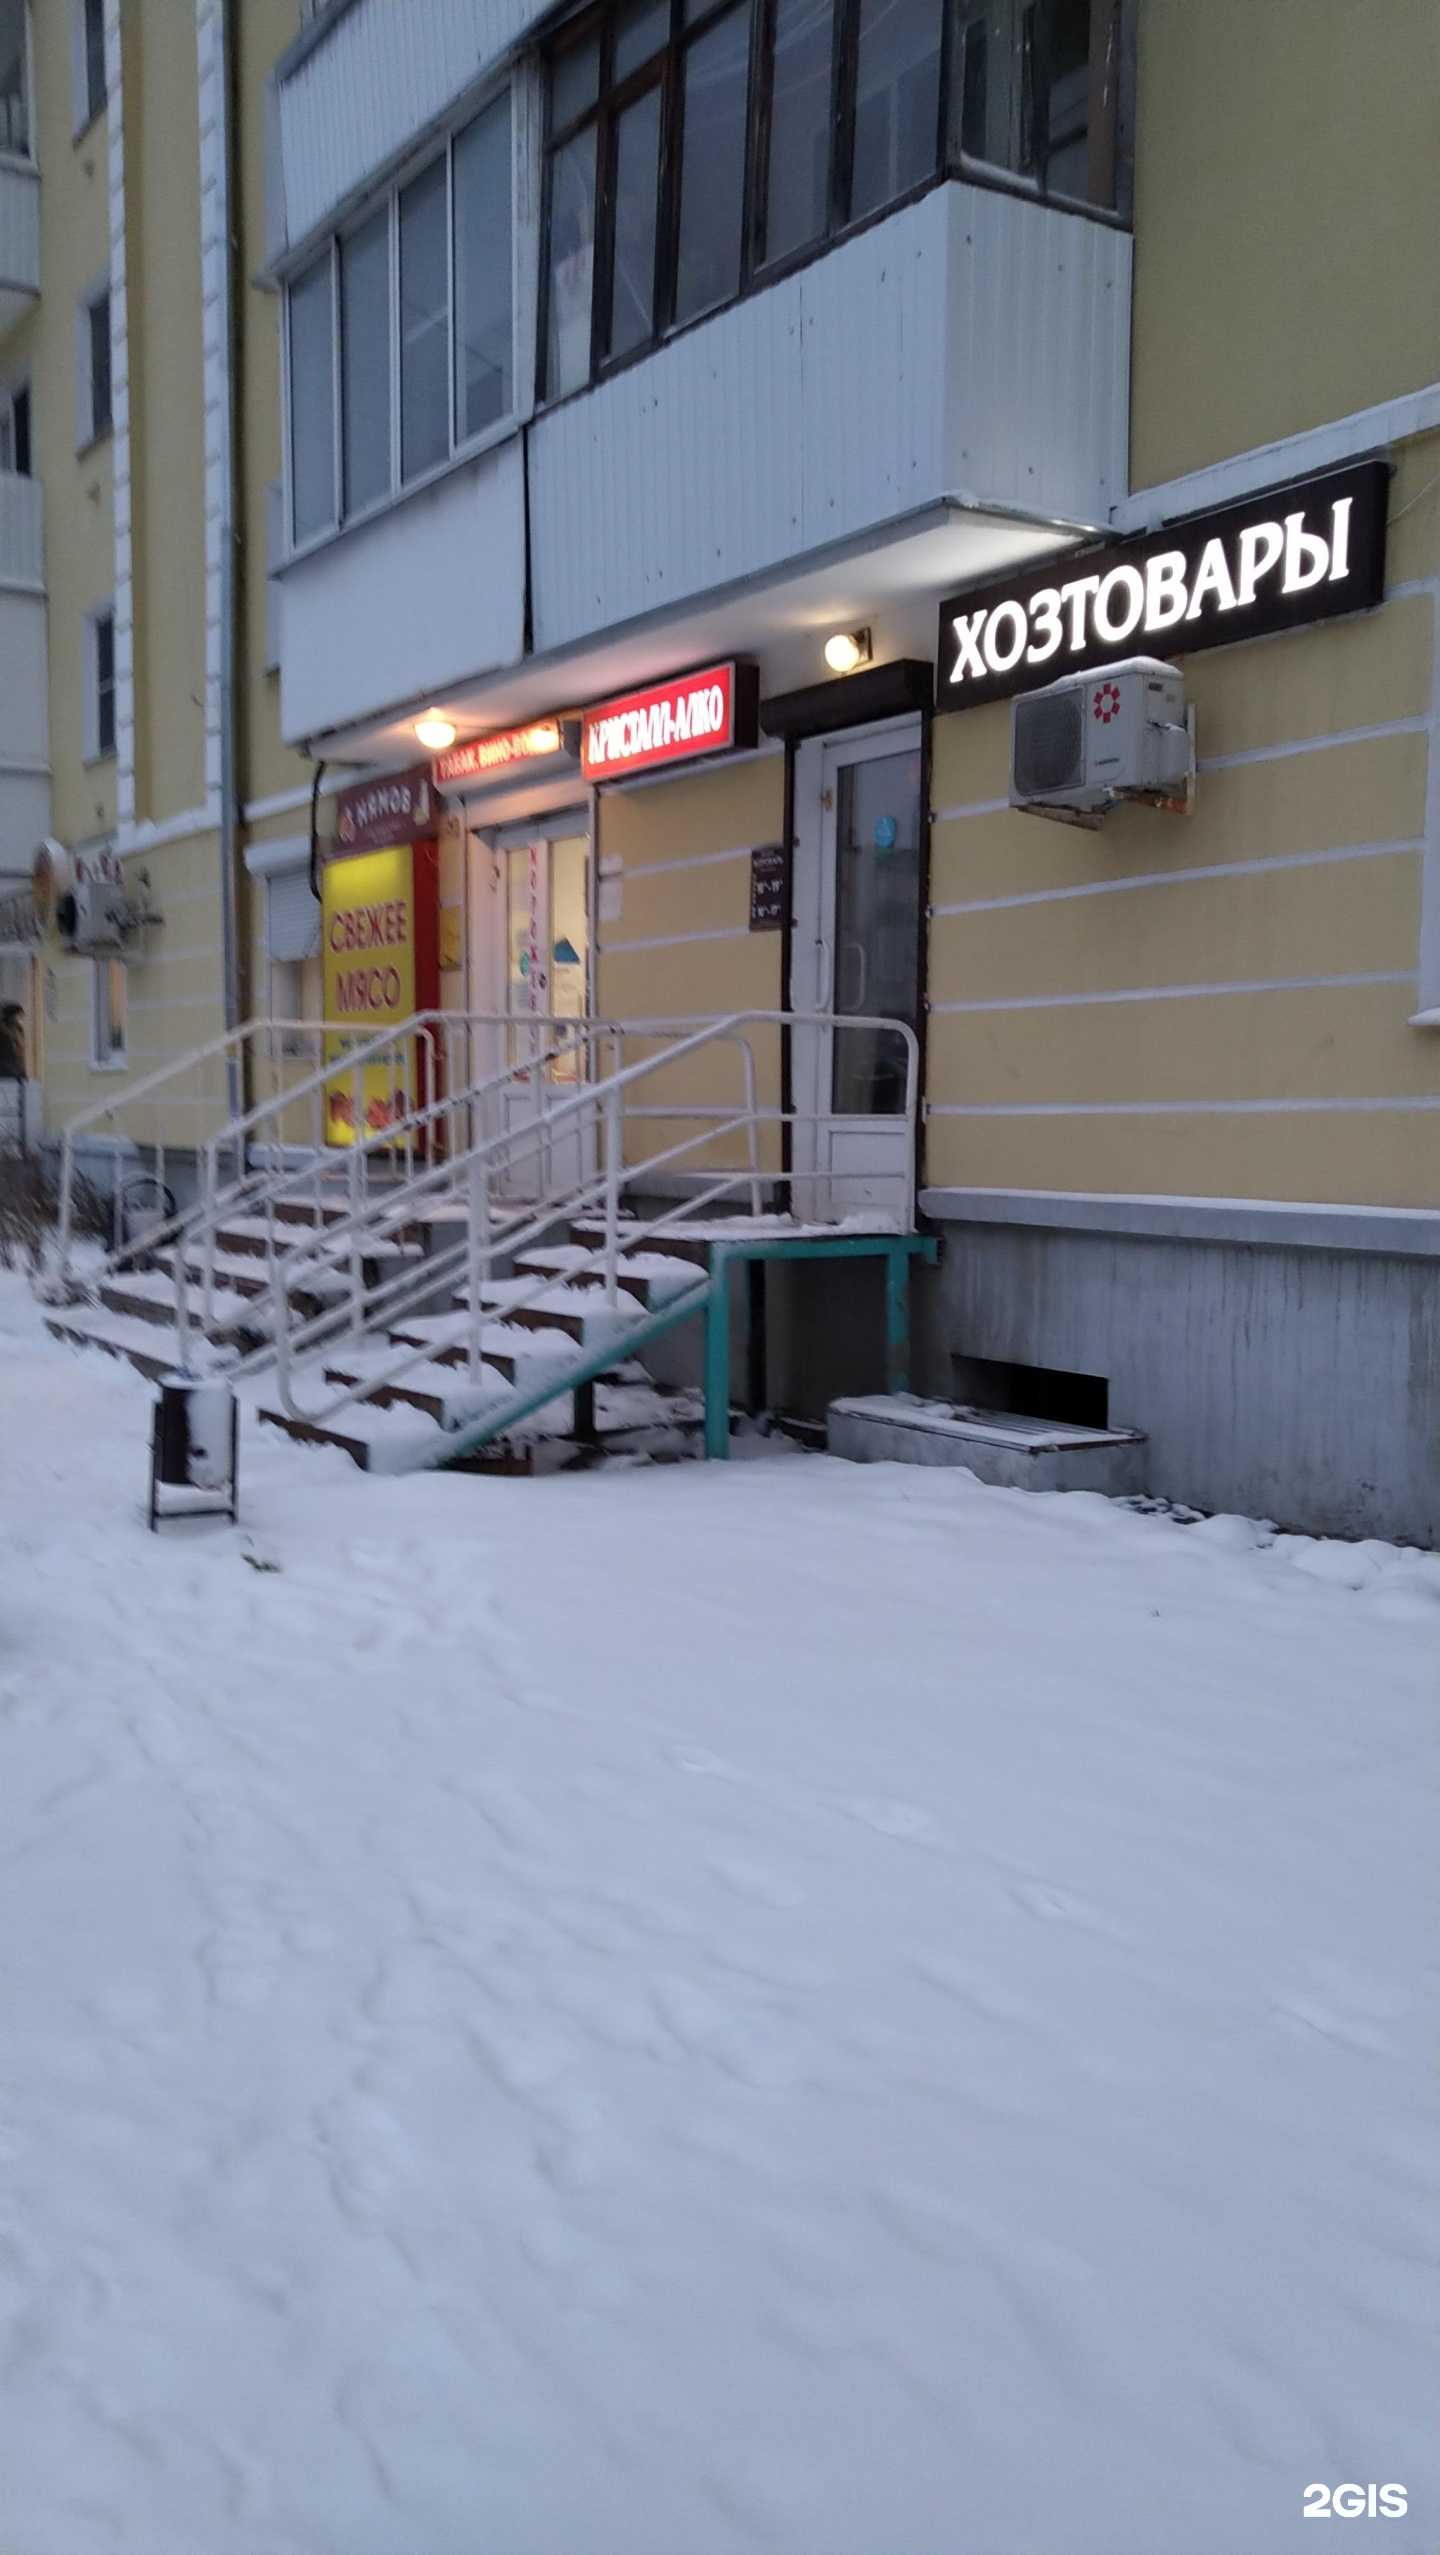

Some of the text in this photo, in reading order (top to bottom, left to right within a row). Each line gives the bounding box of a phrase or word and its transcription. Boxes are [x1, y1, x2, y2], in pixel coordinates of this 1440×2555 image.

[949, 497, 1354, 684] ХОЗТОВАРЫ
[329, 898, 407, 954] СВЕЖЕЕ
[335, 964, 401, 1012] МЯСО
